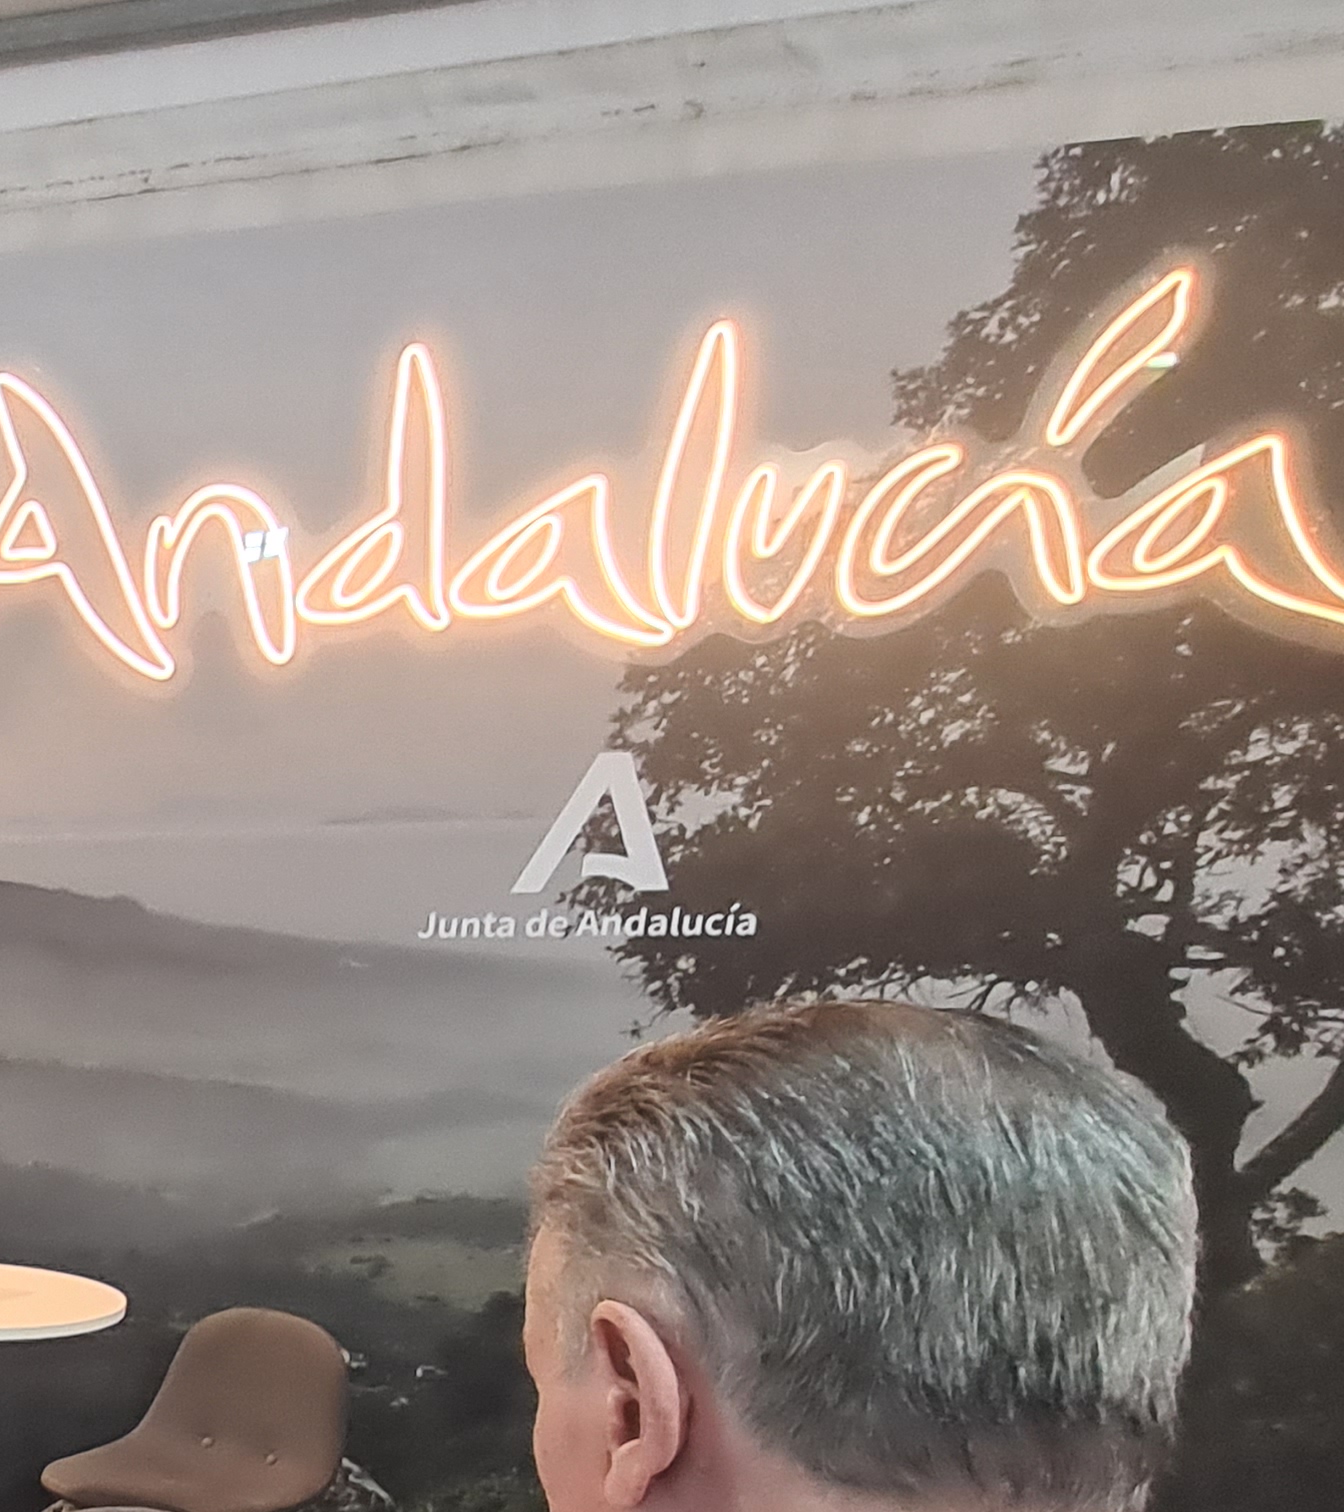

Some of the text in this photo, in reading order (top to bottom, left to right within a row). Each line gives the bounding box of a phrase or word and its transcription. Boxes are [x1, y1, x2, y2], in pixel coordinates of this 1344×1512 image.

[417, 902, 758, 940] Junta de Andalucía
